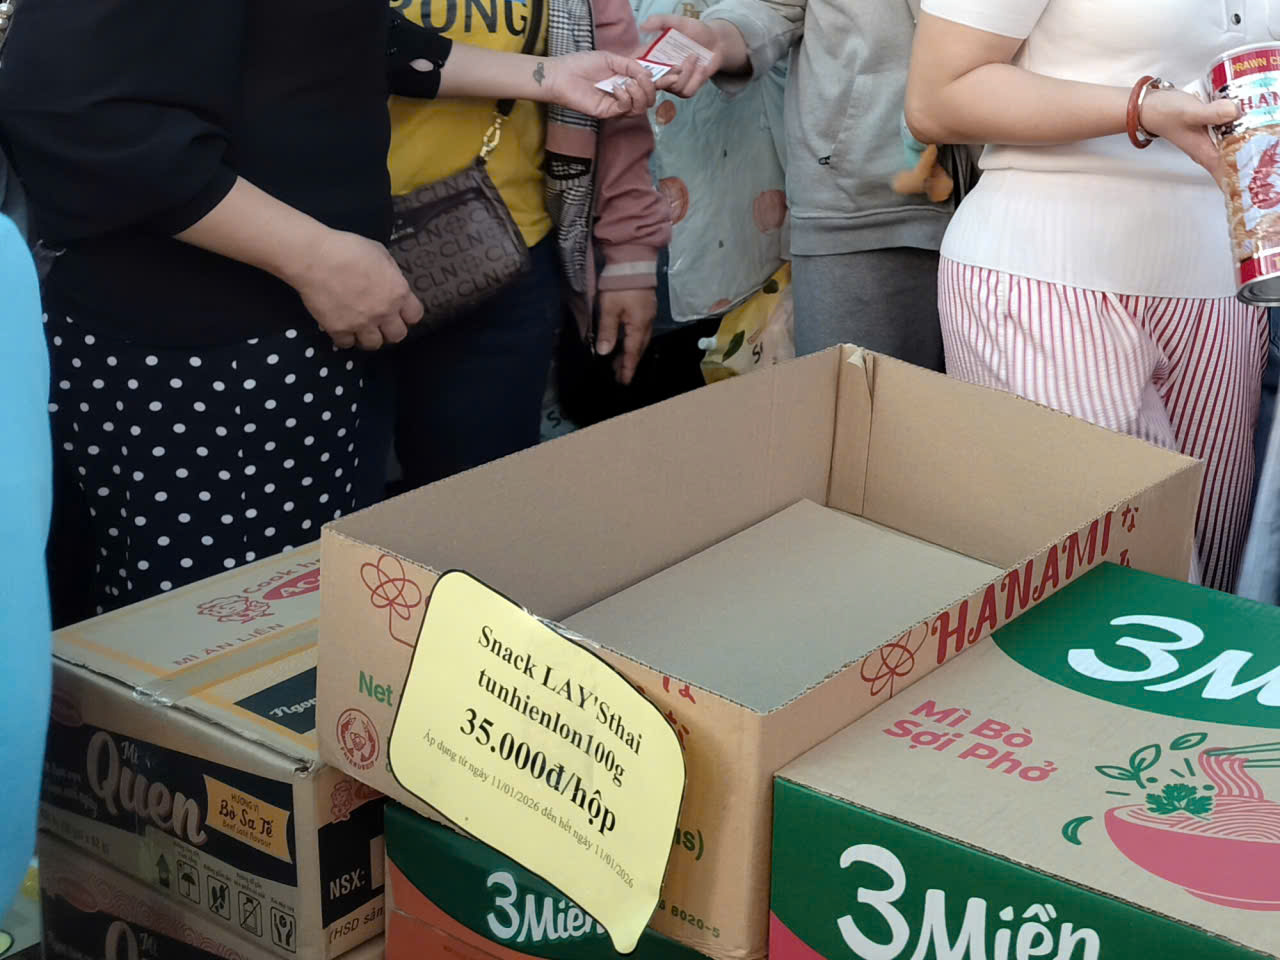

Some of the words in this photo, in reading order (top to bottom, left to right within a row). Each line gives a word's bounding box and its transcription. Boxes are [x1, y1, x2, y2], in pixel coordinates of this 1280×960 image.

[243, 567, 299, 595] Cook
[931, 510, 1114, 666] HANAMI
[477, 624, 536, 680] Snack
[360, 670, 393, 708] Net
[477, 667, 626, 788] tunhienlon100g
[882, 719, 965, 752] Sợi
[958, 742, 1058, 782] Phở
[909, 700, 972, 728] Mì
[969, 718, 1033, 749] Bò
[86, 731, 209, 847] Quen
[459, 707, 617, 837] 35.000đ/hộp
[219, 799, 237, 821] Bò
[240, 808, 256, 831] Sa
[259, 817, 275, 839] Tế
[423, 728, 436, 747] Áp
[436, 739, 457, 763] dụng
[491, 775, 541, 813] 11/01/2026
[594, 844, 635, 889] 11/01/2026
[329, 868, 366, 901] NSX:
